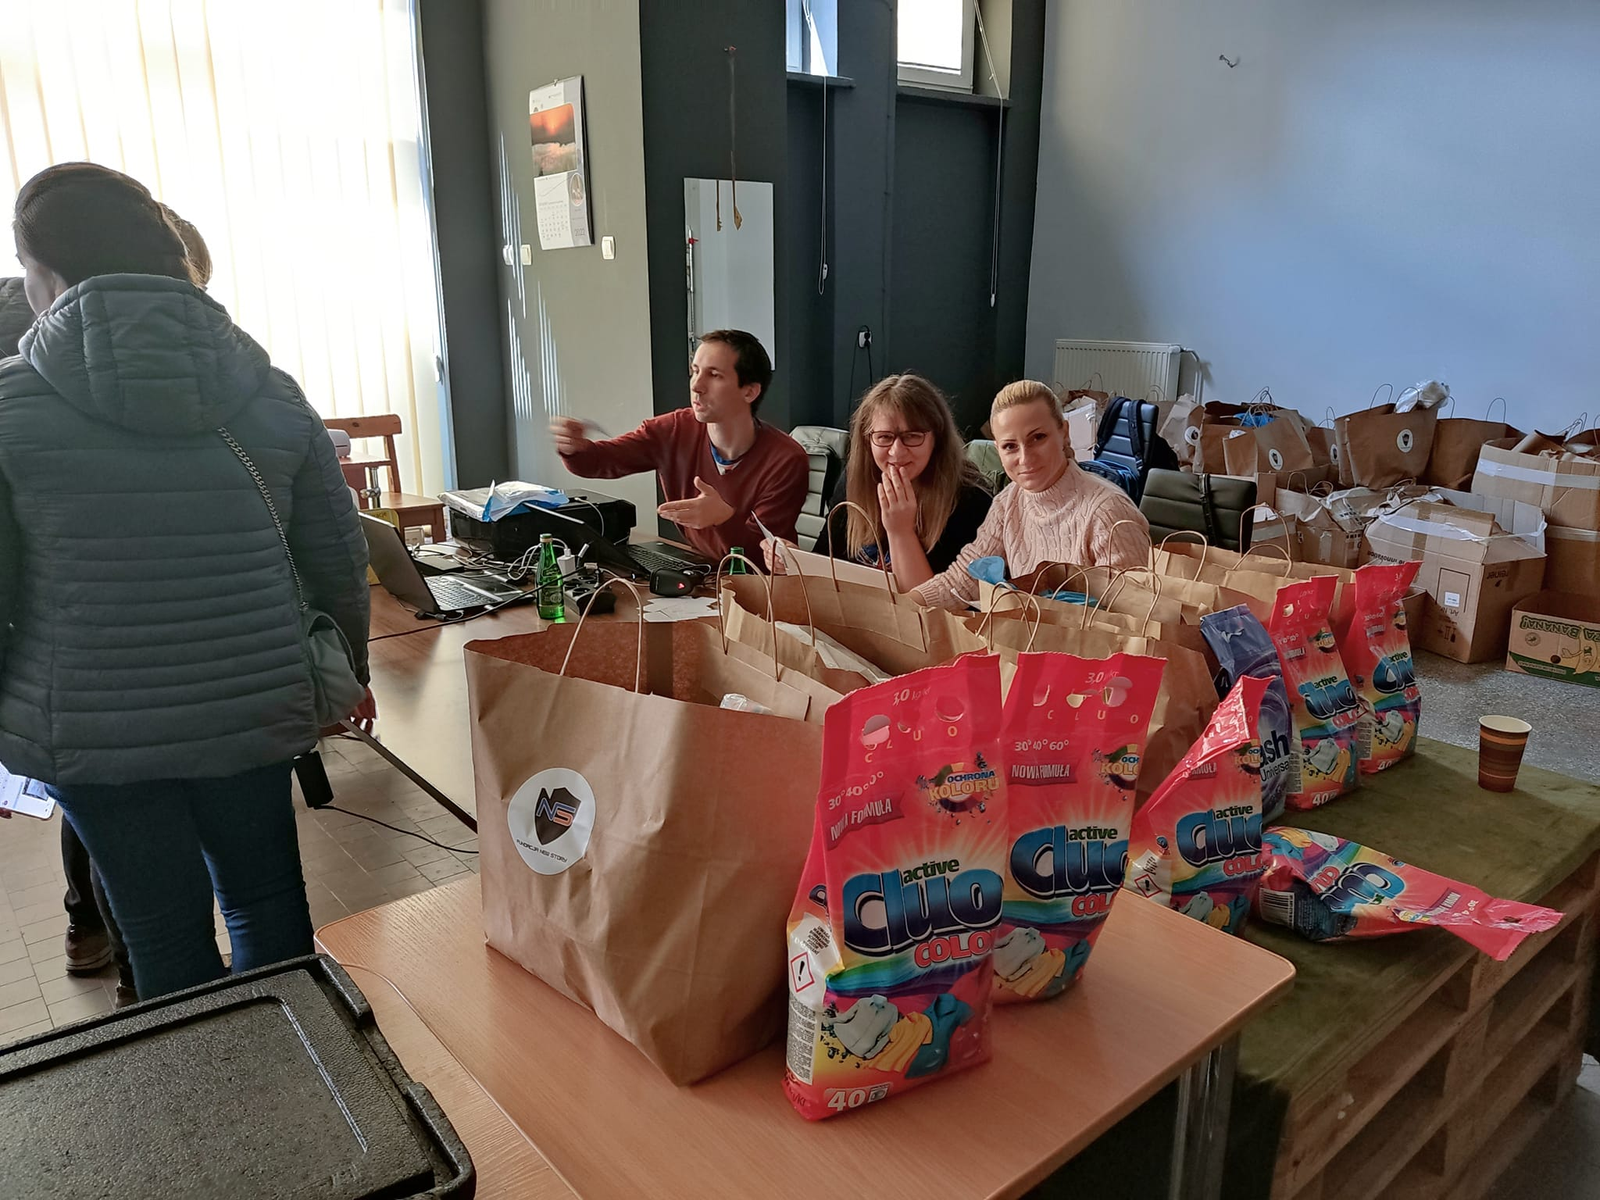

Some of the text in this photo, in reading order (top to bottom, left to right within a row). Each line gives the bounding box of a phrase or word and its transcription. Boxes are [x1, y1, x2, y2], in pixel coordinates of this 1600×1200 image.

[1520, 615, 1581, 640] BANANA!
[1314, 675, 1338, 688] active
[947, 771, 995, 783] OCHRONA
[928, 777, 999, 800] KOLORU
[1312, 793, 1329, 806] 40
[536, 798, 576, 827] NS
[1216, 805, 1253, 819] active
[1069, 826, 1118, 840] active
[903, 858, 960, 884] active
[828, 1089, 866, 1112] 40
